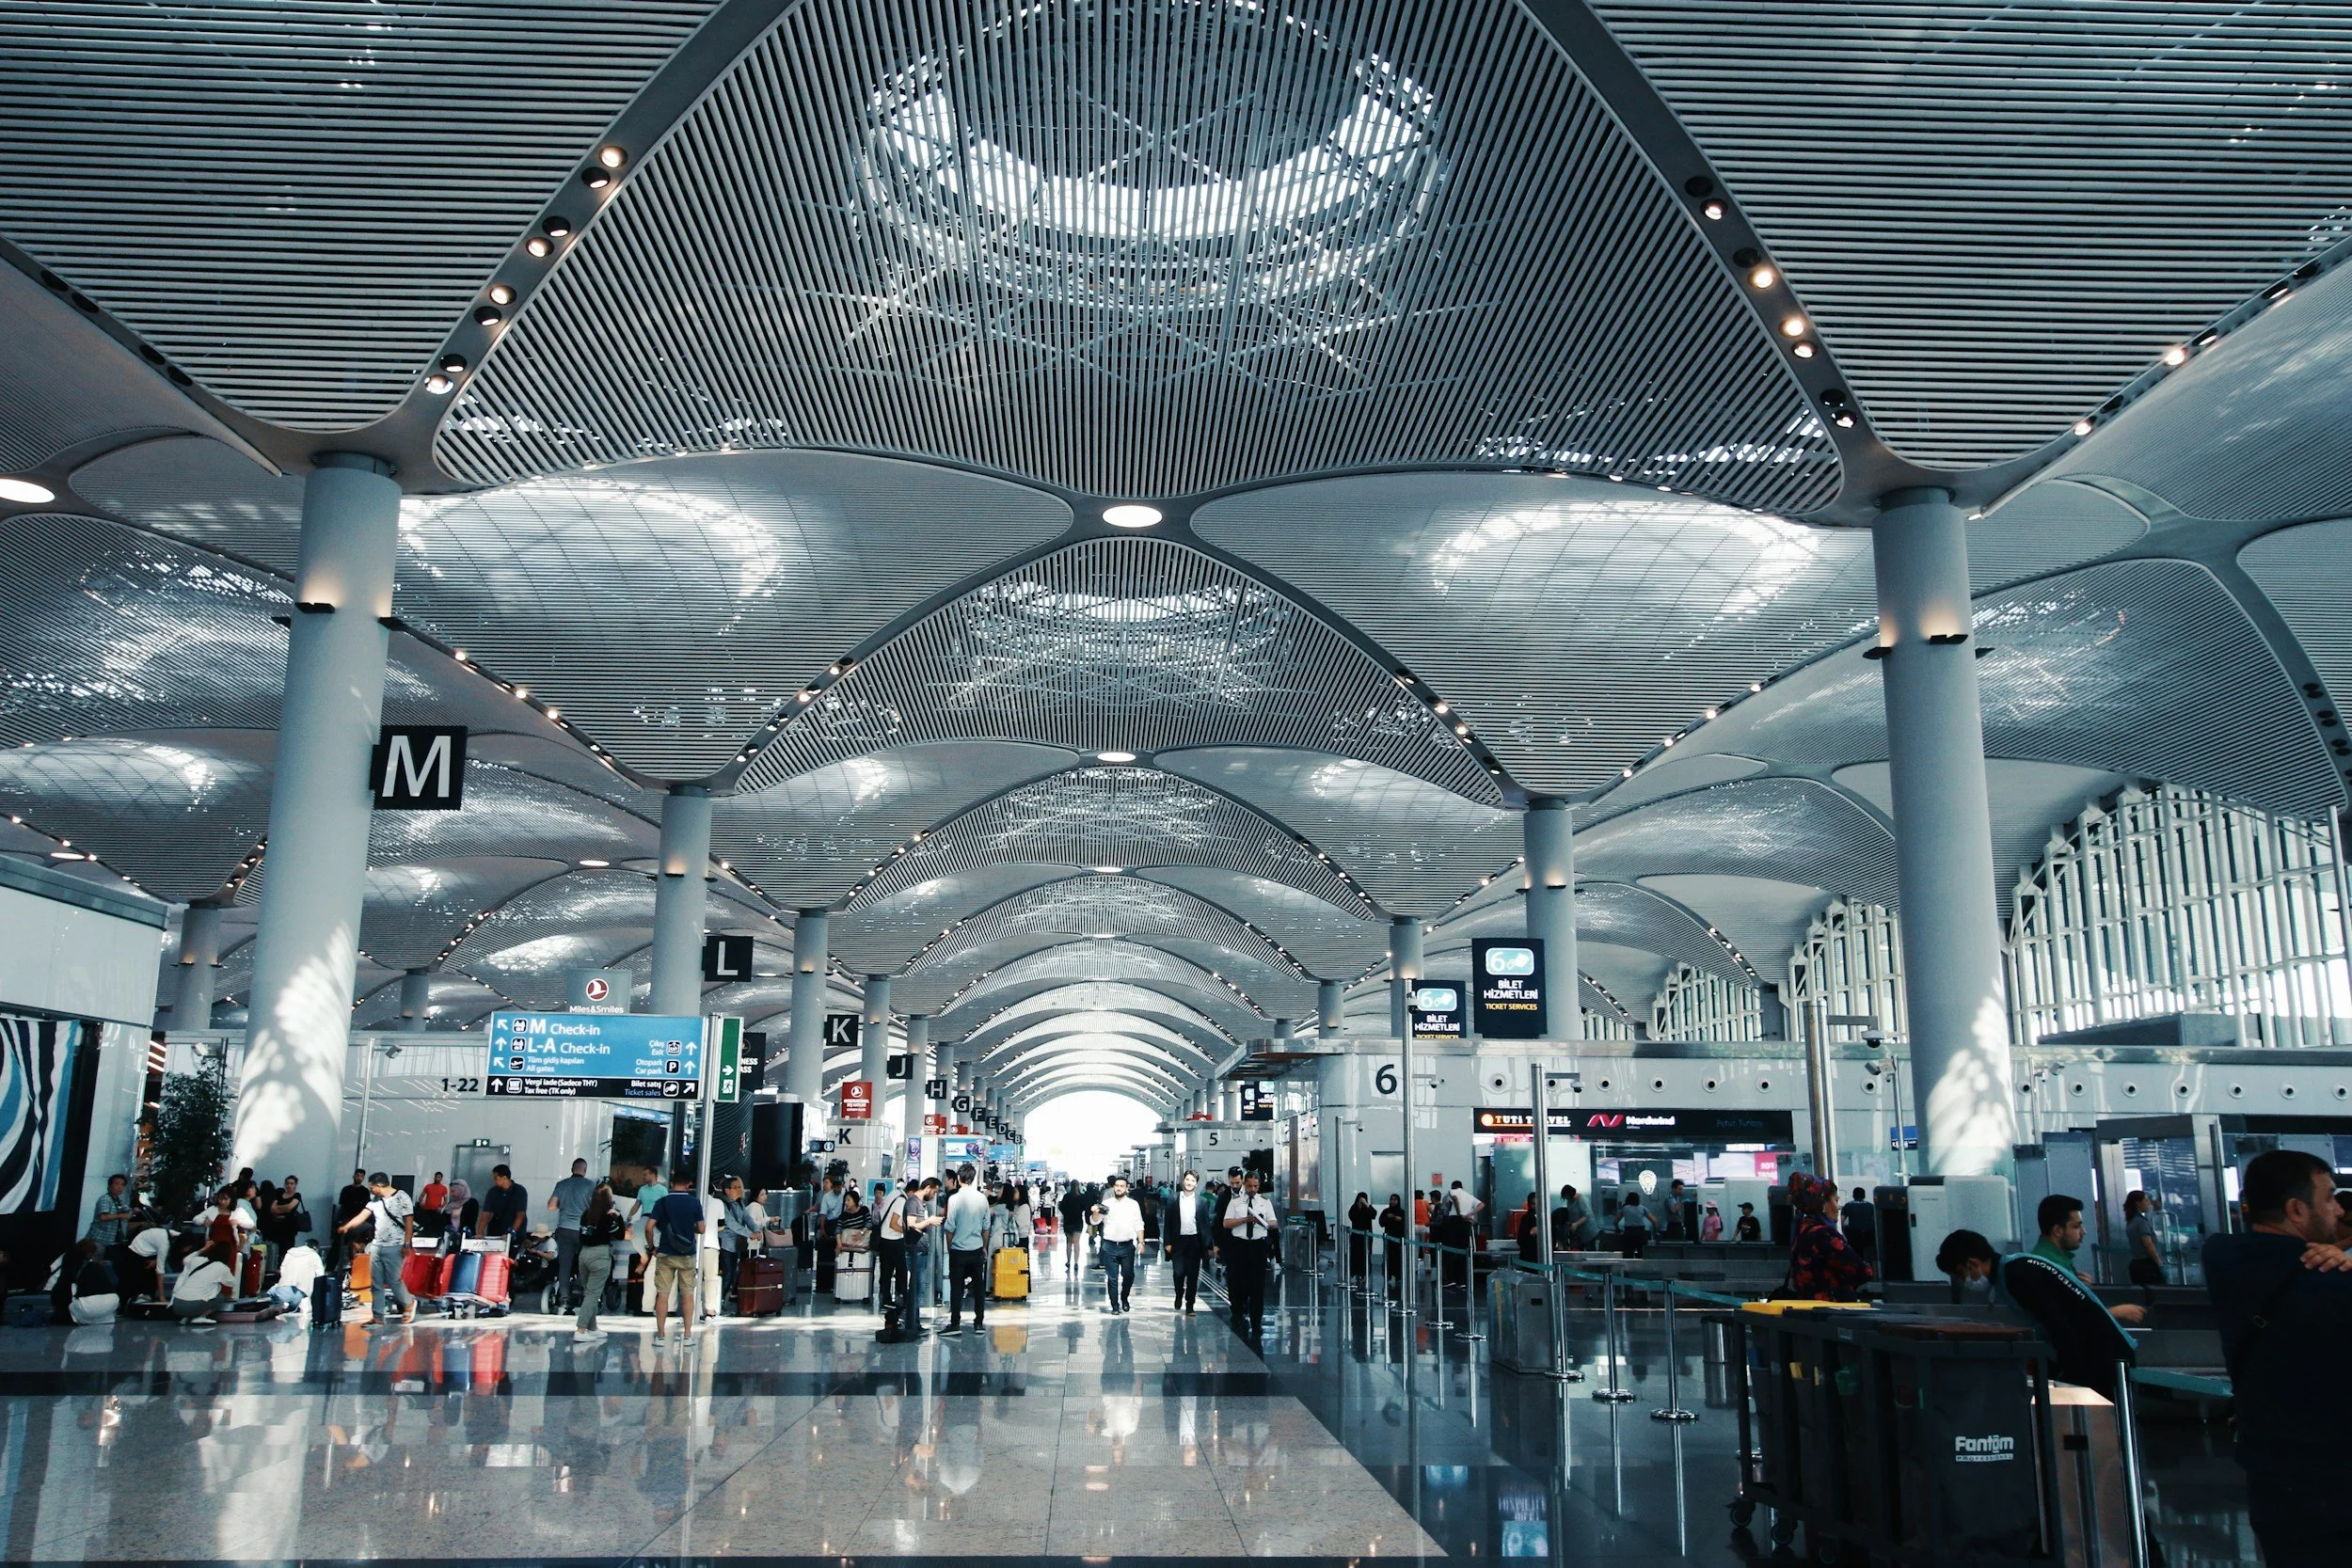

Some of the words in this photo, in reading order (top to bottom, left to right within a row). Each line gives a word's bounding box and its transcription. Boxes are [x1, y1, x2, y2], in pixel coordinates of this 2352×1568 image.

[382, 735, 452, 798] M
[717, 941, 739, 976] L
[1491, 951, 1505, 972] 6
[1498, 978, 1523, 990] BİLET
[1421, 991, 1433, 1008] 6
[1483, 988, 1538, 1000] HİZMETLERİ
[569, 1005, 625, 1014] Miles&Smiles
[1426, 1013, 1448, 1023] BİLET
[529, 1019, 547, 1035] M
[549, 1023, 600, 1036] Check-in
[832, 1018, 851, 1043] K
[1414, 1022, 1460, 1032] HİZMETLERİ
[528, 1037, 556, 1053] L-A
[560, 1042, 611, 1054] Check-in
[741, 1057, 758, 1066] NESS
[896, 1057, 906, 1077] J
[647, 1068, 662, 1076] park
[442, 1078, 479, 1092] 1-22
[525, 1079, 543, 1087] Vergi
[1375, 1064, 1397, 1095] 6
[560, 1087, 577, 1096] only)
[930, 1082, 944, 1098] H
[956, 1098, 966, 1112] G
[976, 1109, 982, 1120] F
[989, 1117, 996, 1128] E
[1626, 1116, 1676, 1126] Nordwind
[999, 1125, 1007, 1133] D
[1008, 1131, 1014, 1139] C
[838, 1129, 851, 1145] K
[1015, 1135, 1021, 1144] B
[1209, 1132, 1218, 1147] 5
